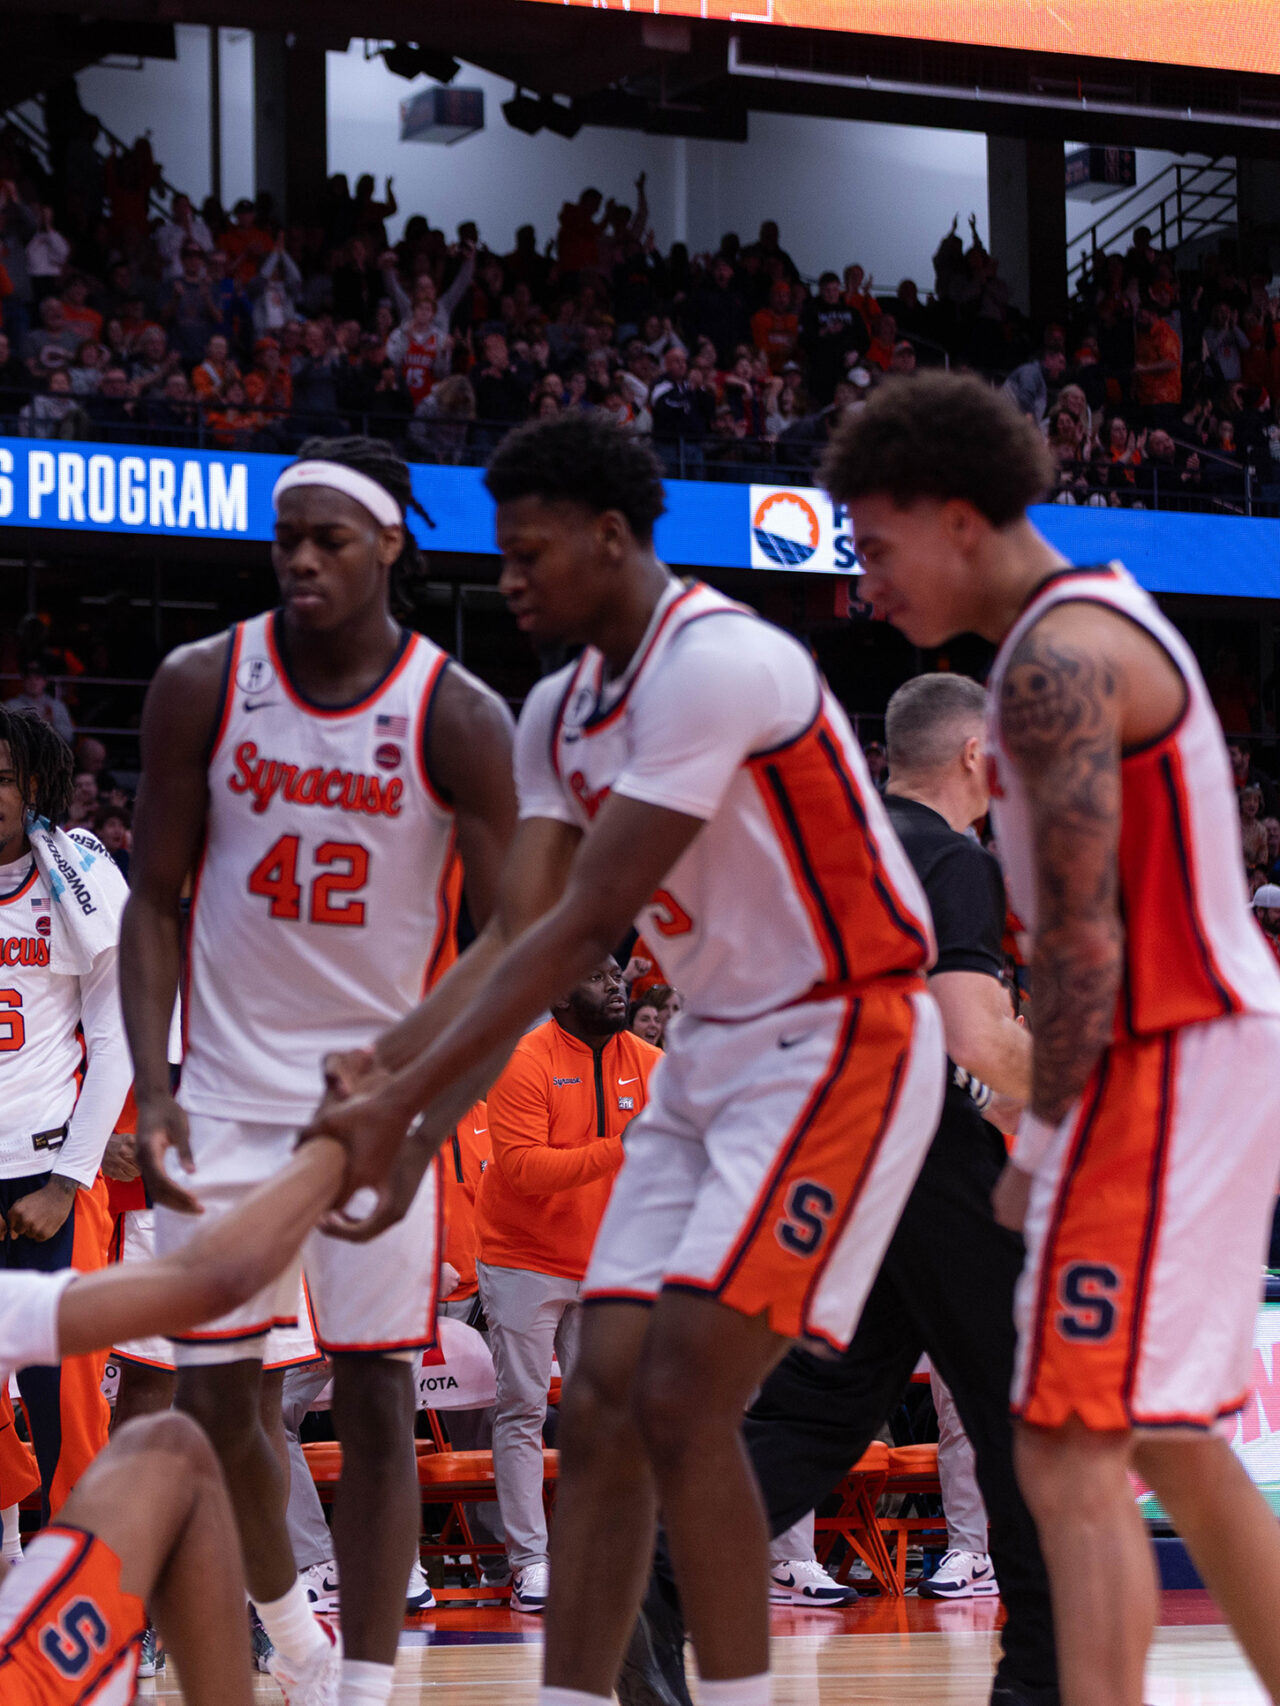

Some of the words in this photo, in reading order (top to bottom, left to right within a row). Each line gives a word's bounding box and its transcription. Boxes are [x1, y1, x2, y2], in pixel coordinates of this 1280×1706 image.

[28, 450, 249, 532] PROGRAM
[228, 741, 405, 818] Syracuse
[247, 834, 370, 928] 42
[775, 1178, 836, 1258] S
[1055, 1260, 1122, 1343] S
[39, 1595, 110, 1680] S
